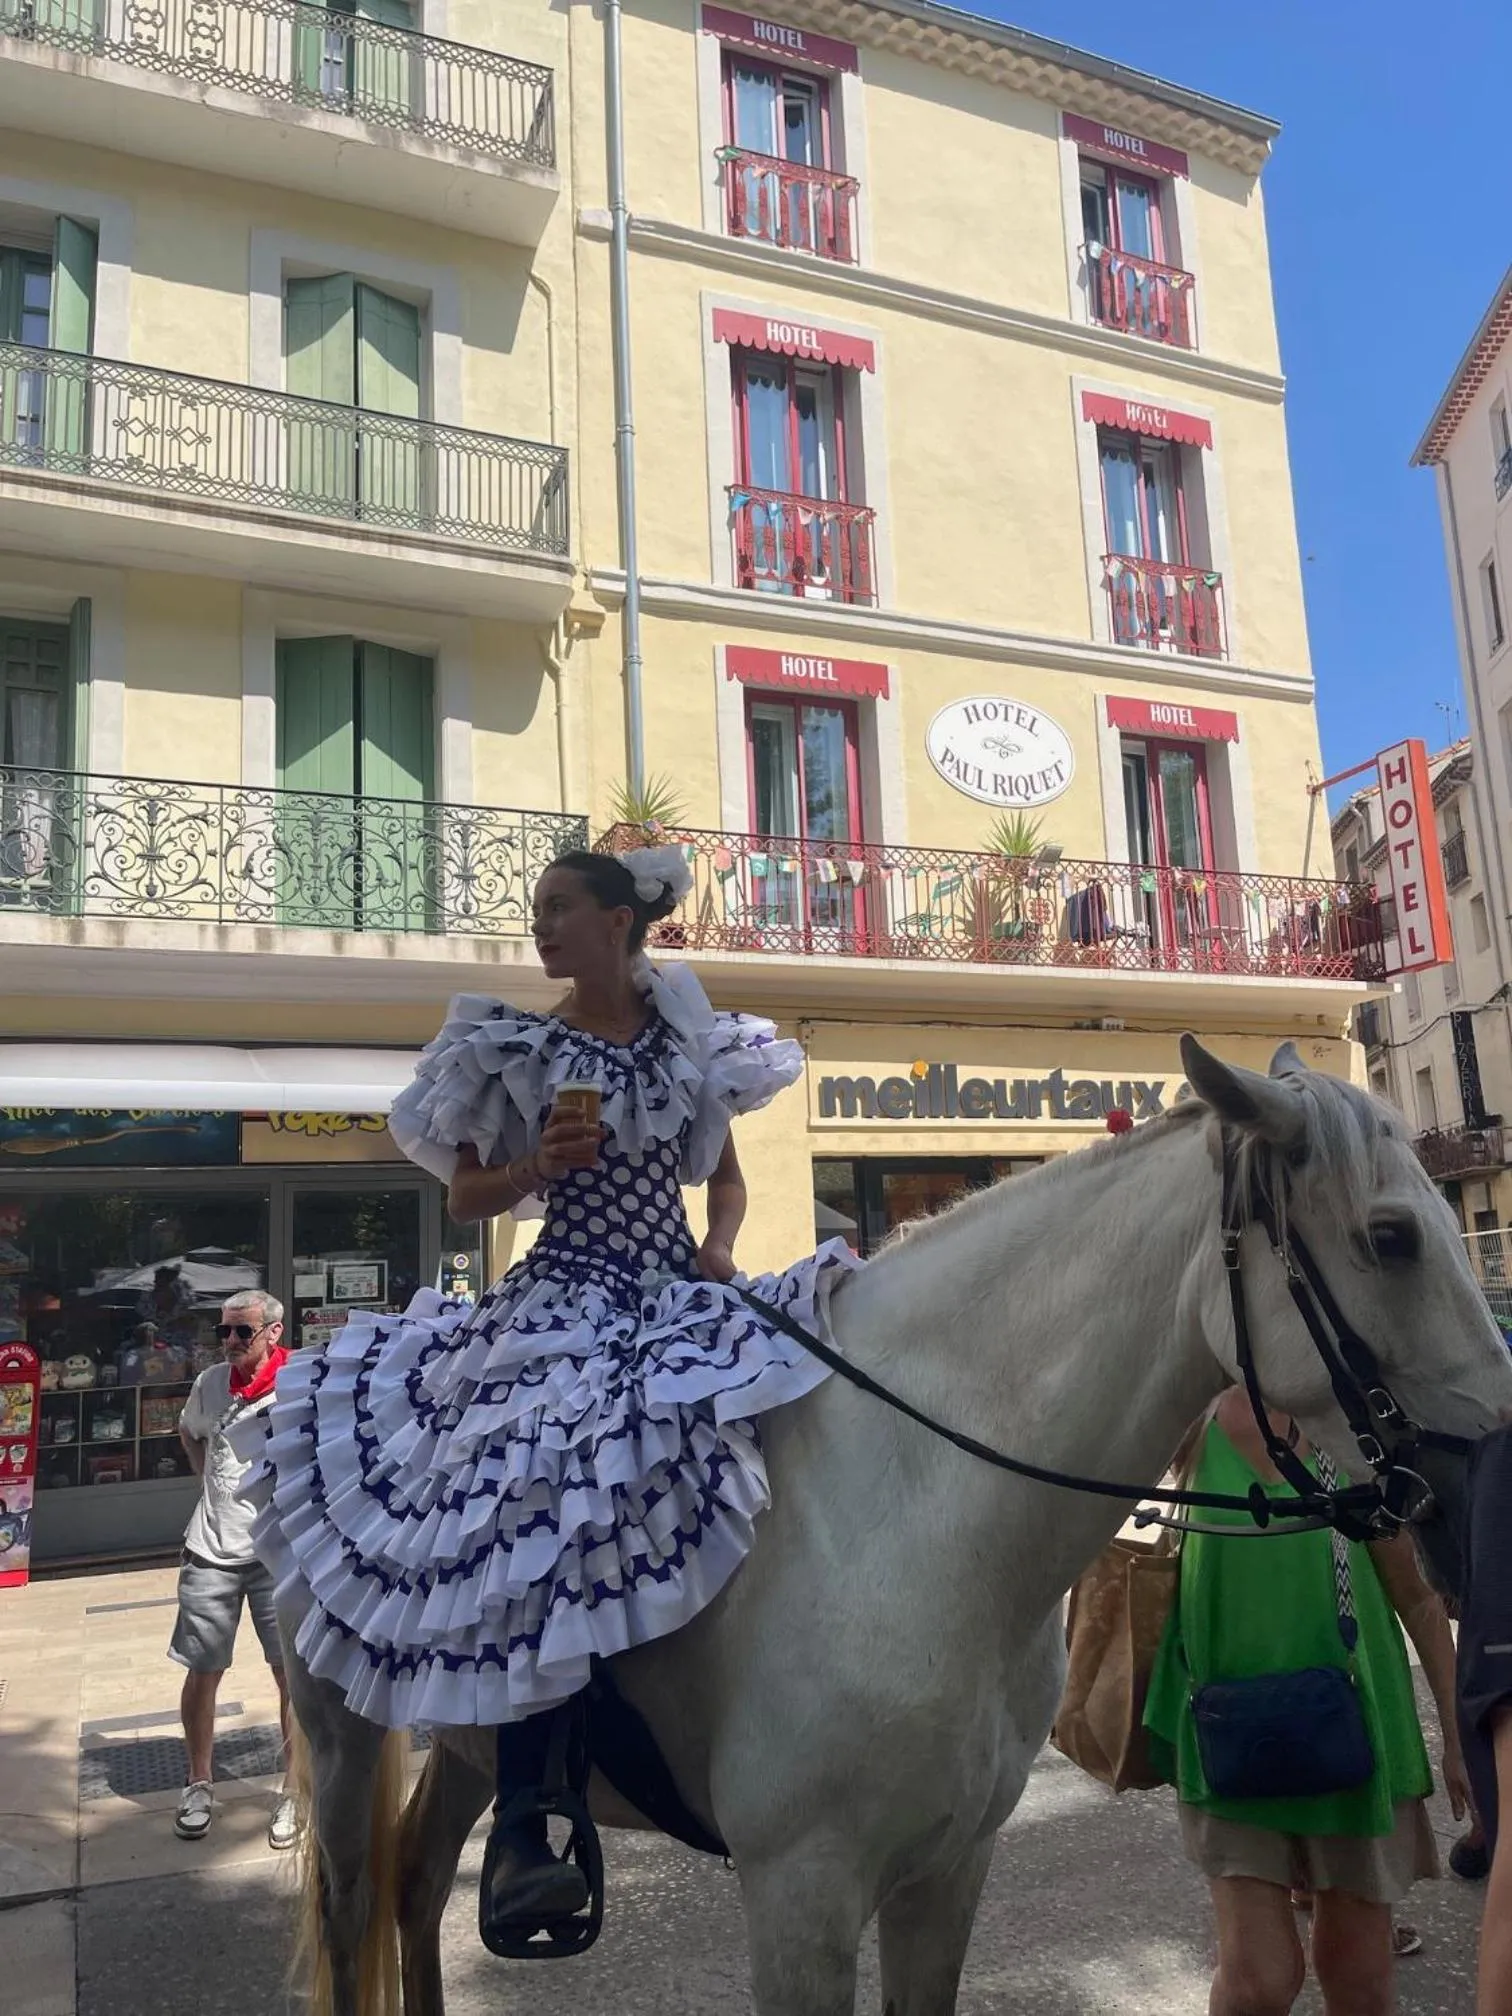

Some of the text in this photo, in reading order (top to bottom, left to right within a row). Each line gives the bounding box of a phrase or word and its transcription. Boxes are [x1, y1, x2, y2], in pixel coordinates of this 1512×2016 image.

[753, 20, 807, 51] HOTEL
[1104, 128, 1148, 157] HOTEL
[766, 321, 822, 350] HOTEL
[781, 655, 839, 681] HOTEL
[963, 702, 1039, 737] HOTEL
[1150, 703, 1197, 727] HOTEL
[939, 747, 1065, 801] PAUL RIQUET
[1384, 756, 1425, 955] HOTEL
[1453, 1011, 1478, 1129] PIZZERIA
[818, 1060, 1166, 1119] meilleurtaux
